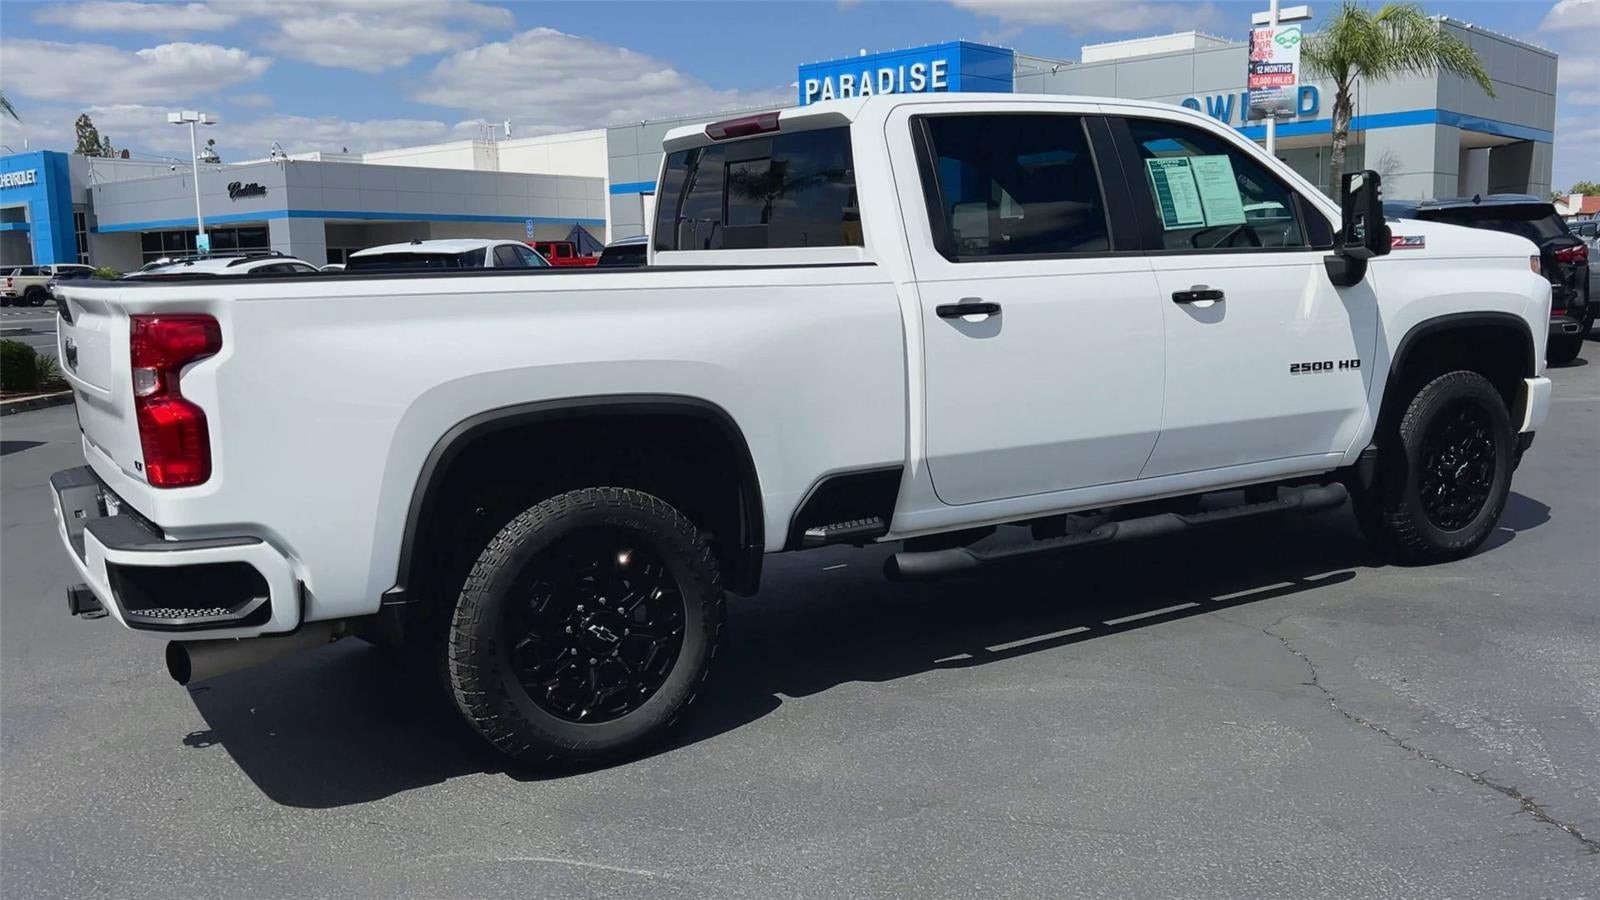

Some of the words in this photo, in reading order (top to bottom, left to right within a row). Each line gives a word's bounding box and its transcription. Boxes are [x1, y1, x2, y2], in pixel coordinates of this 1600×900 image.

[1256, 65, 1263, 74] 12
[1264, 64, 1291, 73] MONTHS
[805, 60, 947, 104] PARADISE
[1273, 75, 1293, 83] MILES
[1290, 361, 1334, 373] 2500
[1339, 359, 1361, 369] HD
